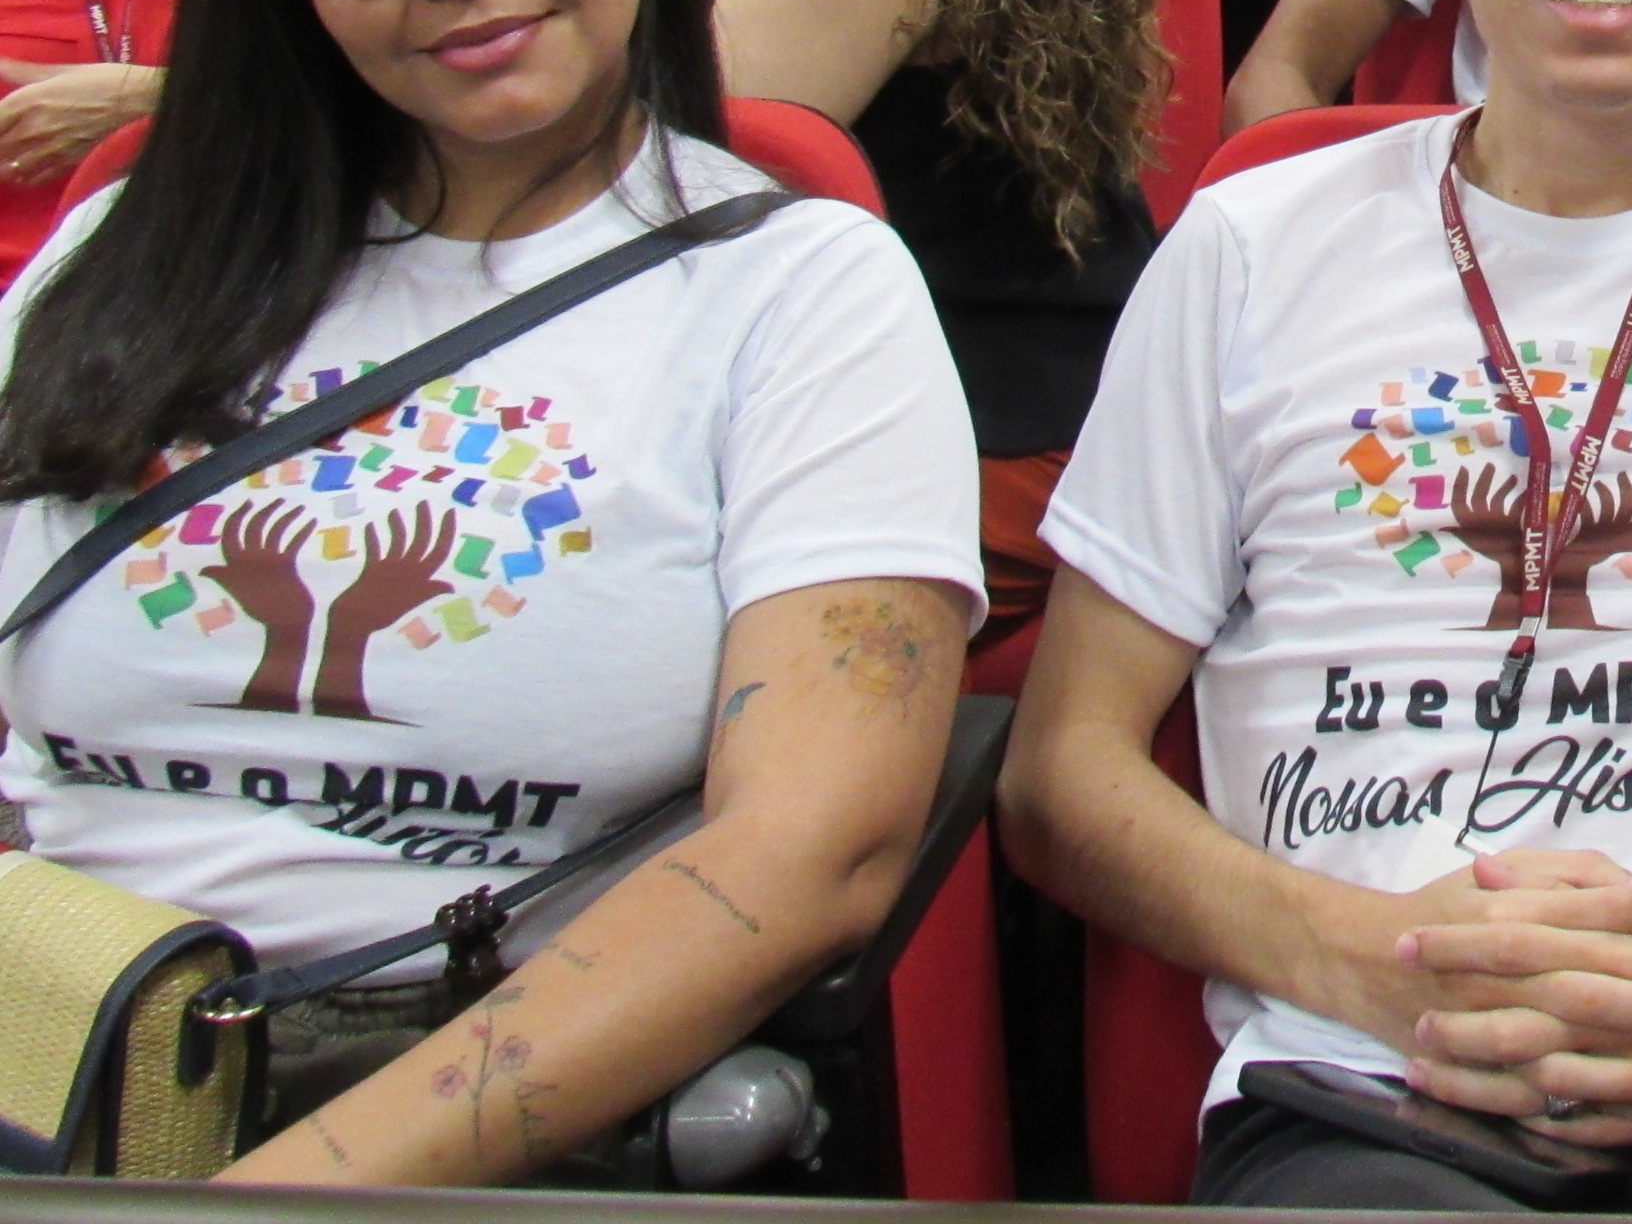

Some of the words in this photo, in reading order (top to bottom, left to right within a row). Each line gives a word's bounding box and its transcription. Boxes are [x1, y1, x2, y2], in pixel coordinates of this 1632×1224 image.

[1446, 225, 1475, 274] MPMT
[1500, 366, 1533, 406] MPMT
[1571, 435, 1602, 497] MPMT
[1523, 527, 1545, 592] MPMT
[1315, 666, 1383, 733] Eu
[1405, 679, 1449, 728] e
[1259, 745, 1453, 850] Nossas
